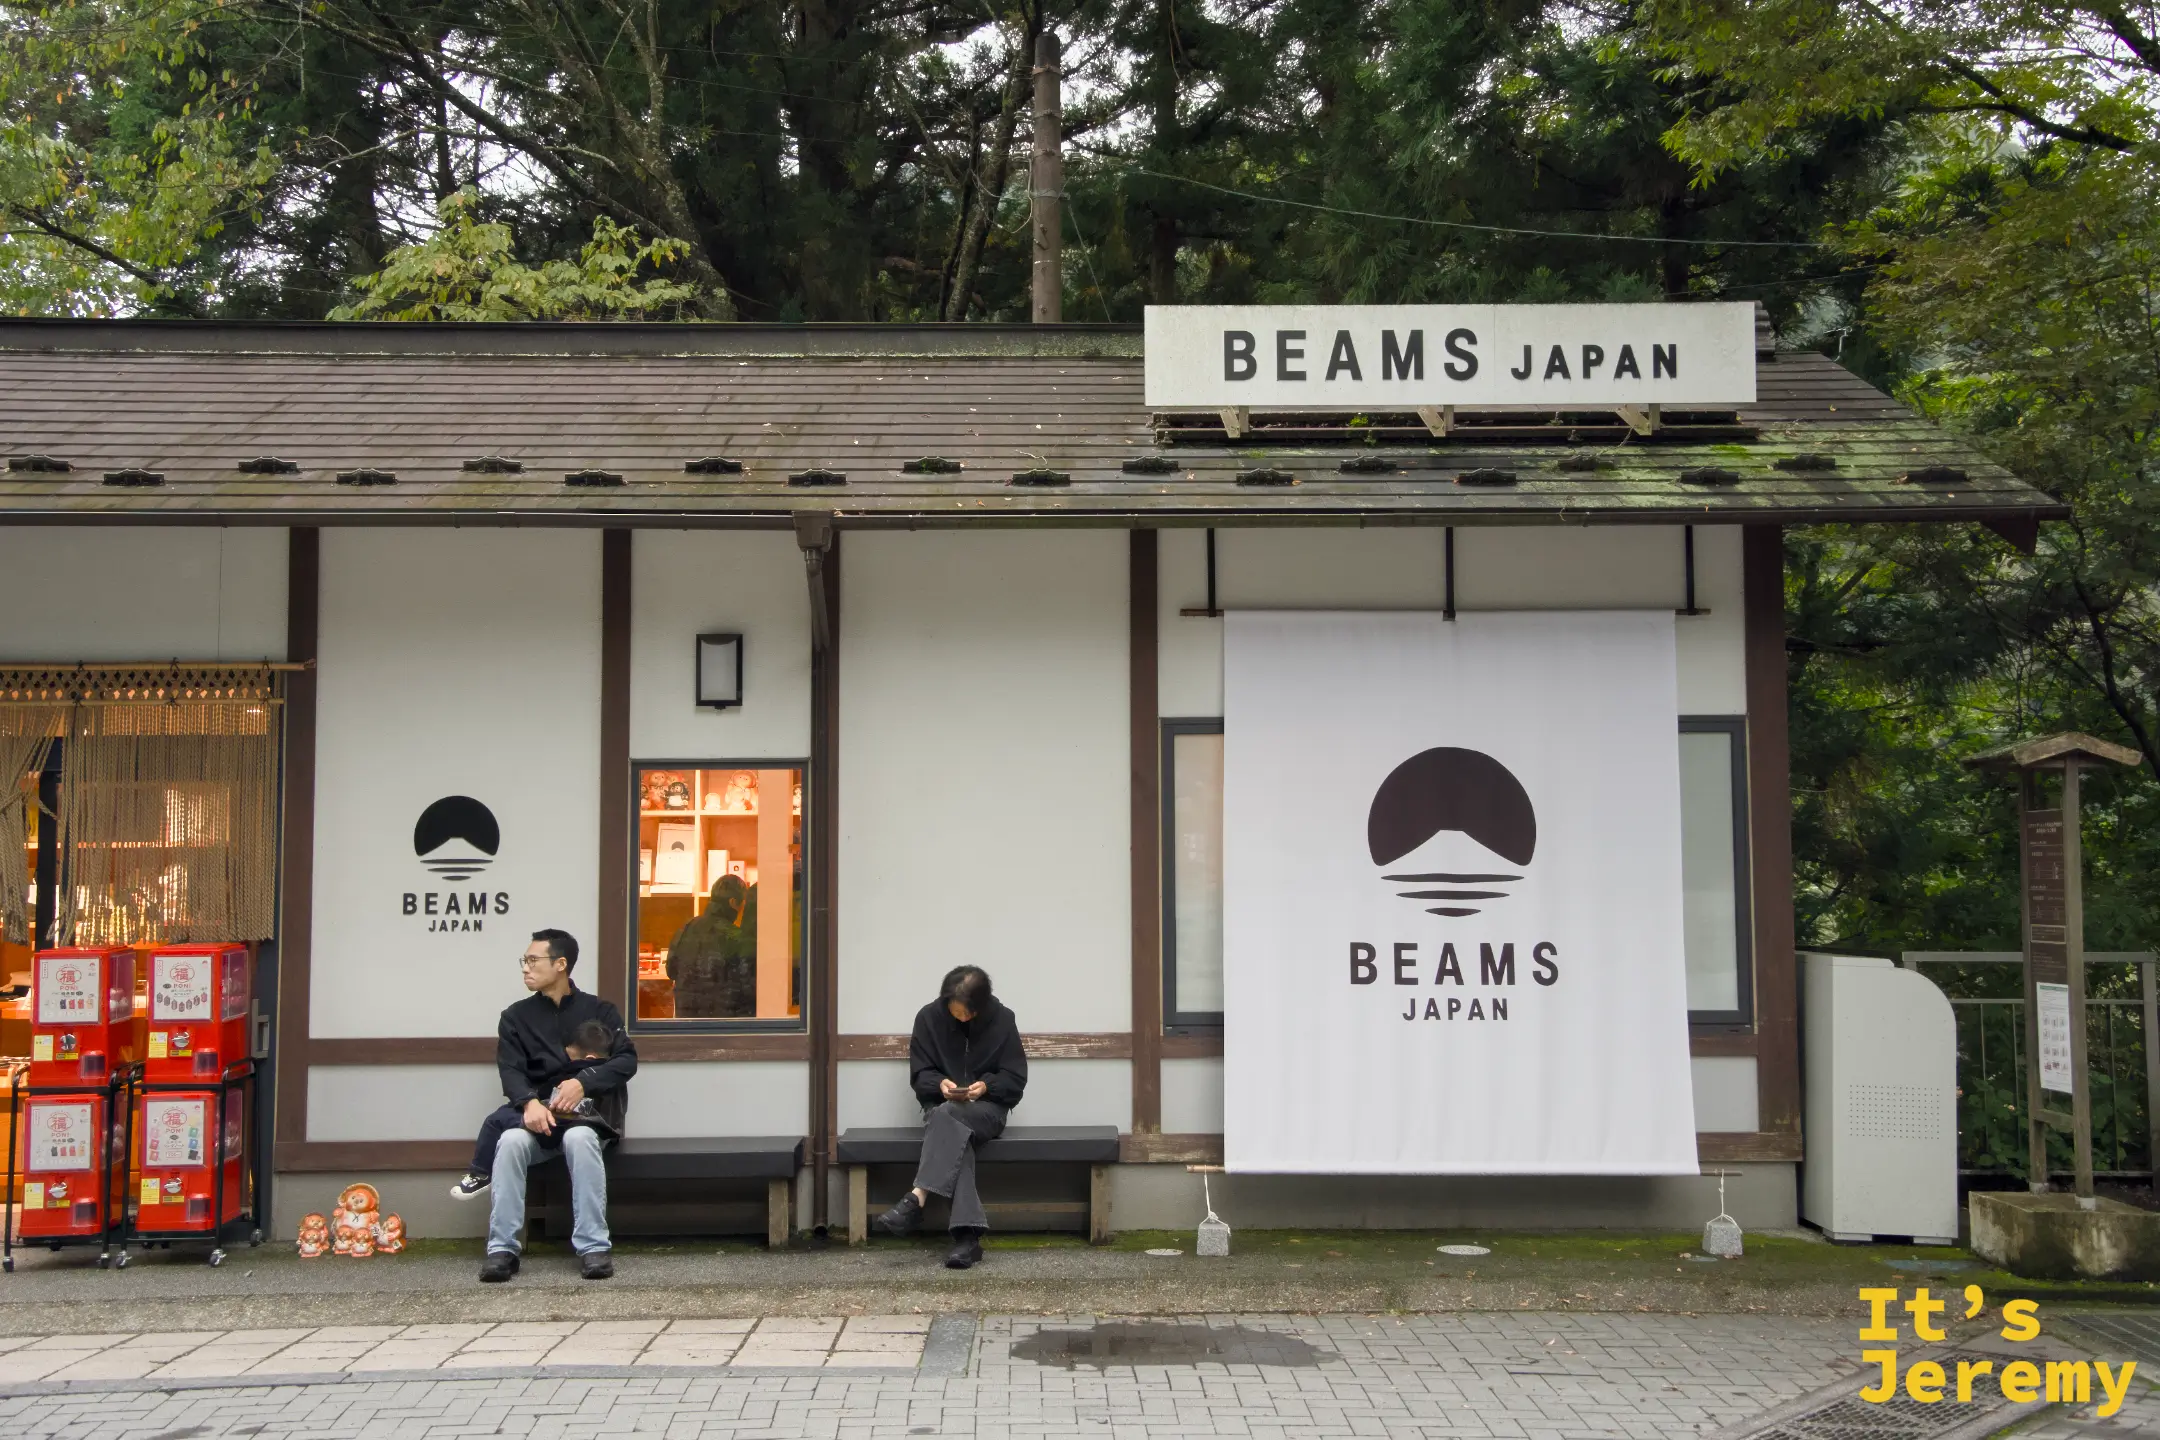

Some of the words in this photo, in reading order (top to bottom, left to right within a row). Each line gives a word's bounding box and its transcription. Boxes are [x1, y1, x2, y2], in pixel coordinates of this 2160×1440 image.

[1224, 329, 1478, 381] BEAMS
[1511, 344, 1676, 380] JAPAN
[403, 892, 509, 915] BEAMS
[429, 920, 482, 932] JAPAN
[1350, 942, 1558, 986] BEAMS
[59, 970, 75, 983] 福
[174, 967, 189, 981] 福
[1403, 998, 1507, 1020] JAPAN
[50, 1116, 67, 1130] 福
[165, 1112, 181, 1126] 福
